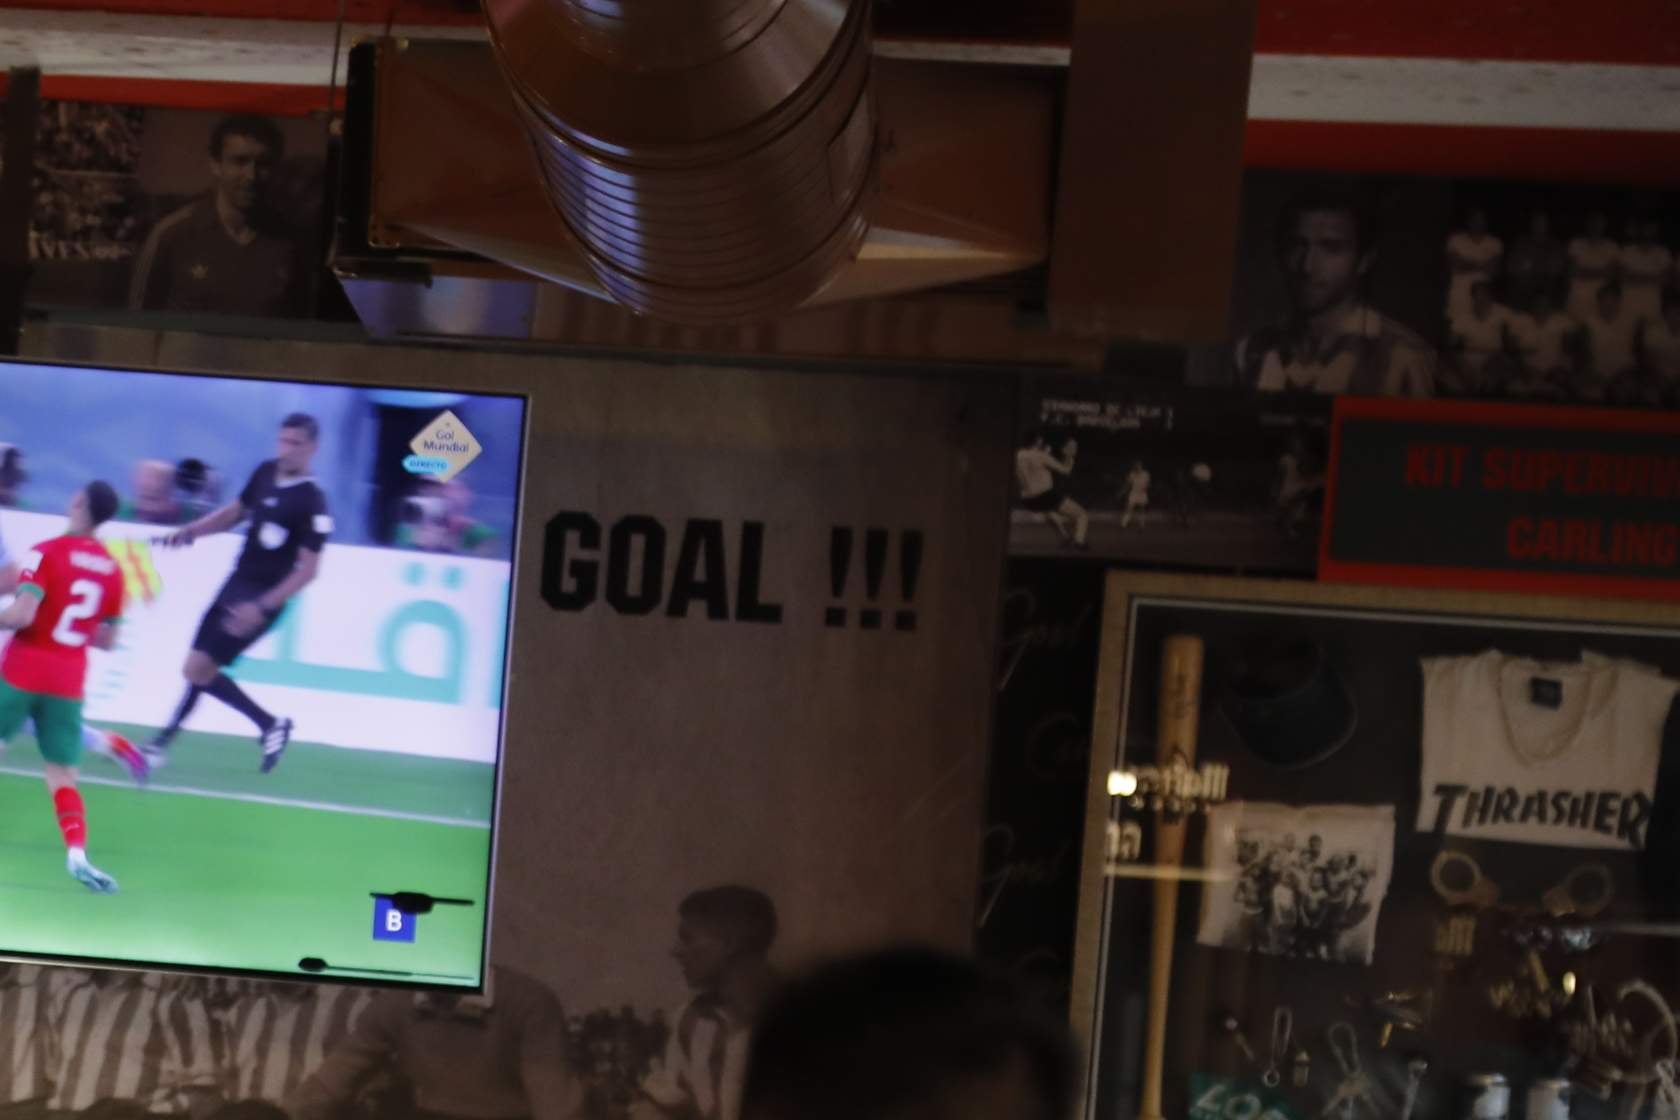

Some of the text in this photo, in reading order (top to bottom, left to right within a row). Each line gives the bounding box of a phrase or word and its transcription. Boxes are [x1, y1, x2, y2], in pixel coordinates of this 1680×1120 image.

[423, 439, 469, 454] Mundial
[435, 430, 455, 441] Gol
[1405, 444, 1469, 489] KIT
[539, 511, 925, 632] GOAL !!!
[51, 578, 103, 647] 2
[1433, 783, 1653, 852] THRASHER
[385, 908, 403, 932] B
